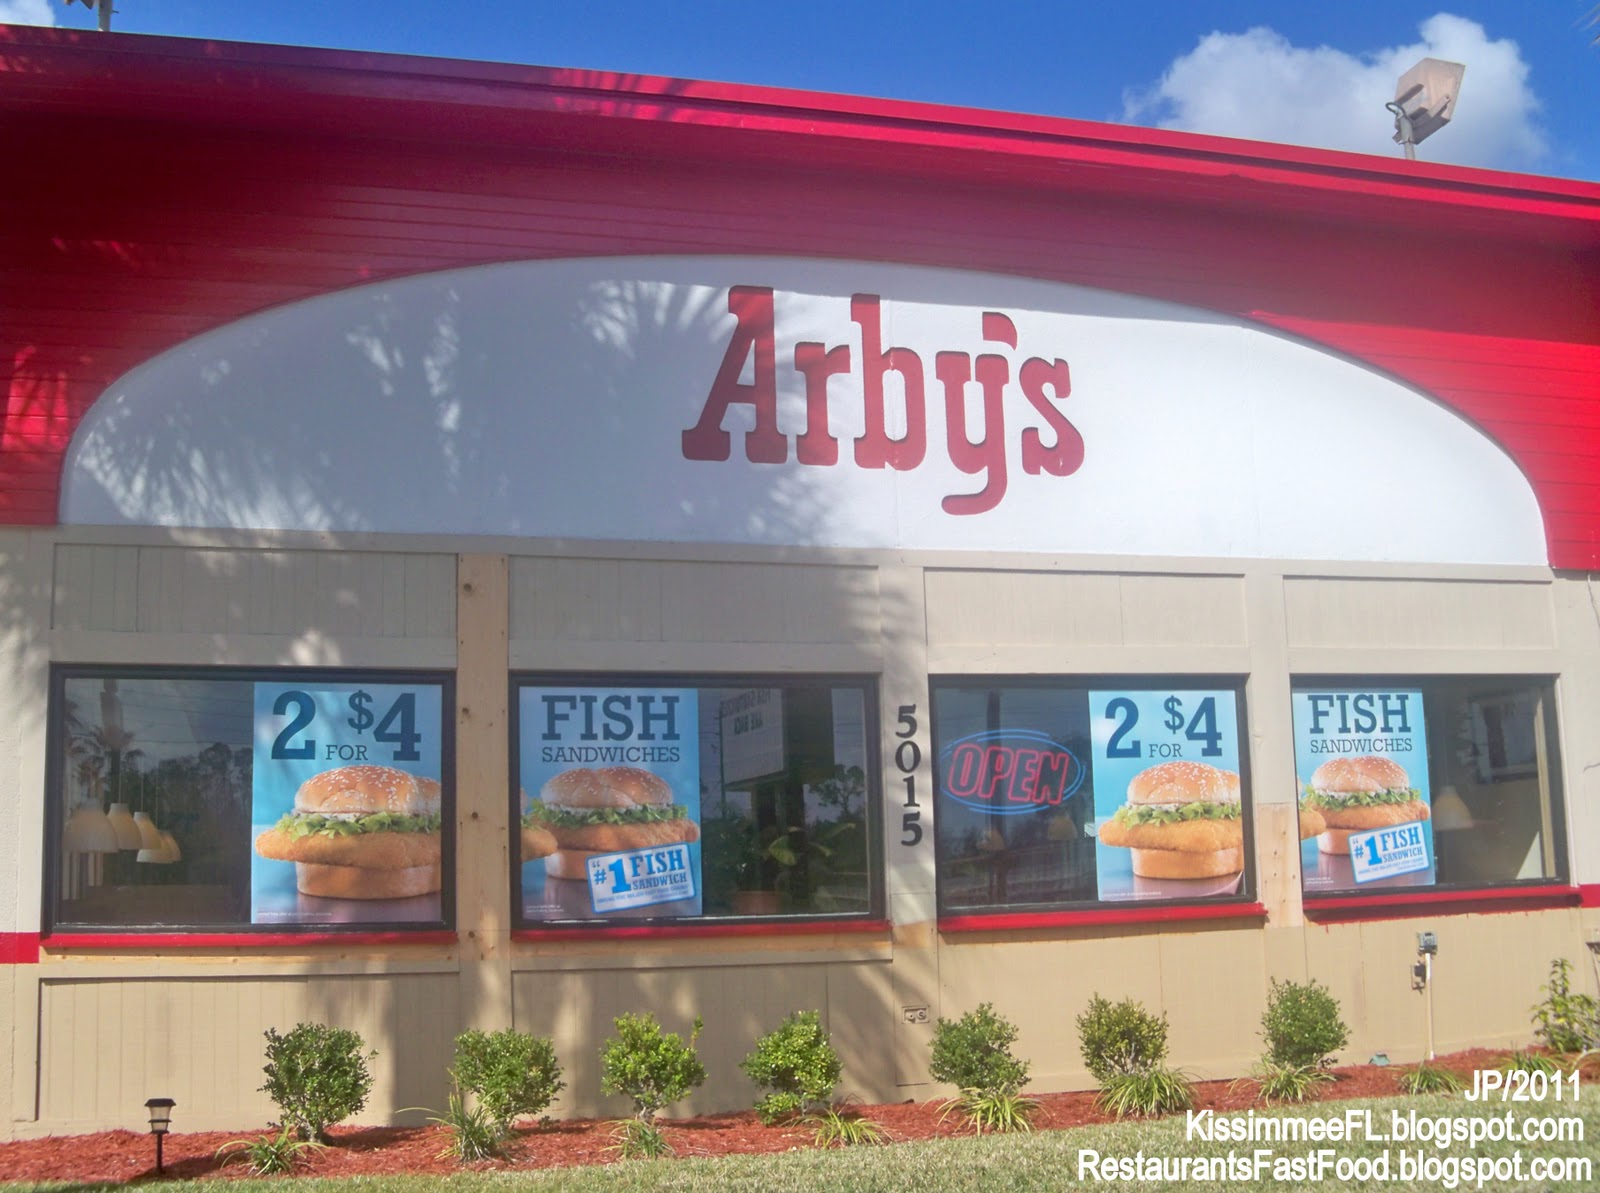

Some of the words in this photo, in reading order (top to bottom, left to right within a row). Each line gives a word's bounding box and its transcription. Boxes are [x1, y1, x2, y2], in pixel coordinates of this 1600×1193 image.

[681, 285, 1085, 515] Arby's
[271, 691, 316, 760] 2
[325, 744, 369, 761] FOR
[347, 690, 422, 761] $4
[541, 695, 680, 741] FISH
[1105, 697, 1141, 758] 2
[1163, 695, 1222, 757] $4
[1307, 694, 1412, 734] FISH
[541, 746, 681, 763] SANDWICHES
[1148, 743, 1183, 758] FOR
[1309, 738, 1413, 754] SANDWICHES
[948, 744, 1070, 805] OPEN
[1379, 826, 1421, 851] FISH
[1383, 846, 1424, 863] SANDWICH
[629, 849, 685, 878] FISH
[632, 872, 688, 891] SANDWICH
